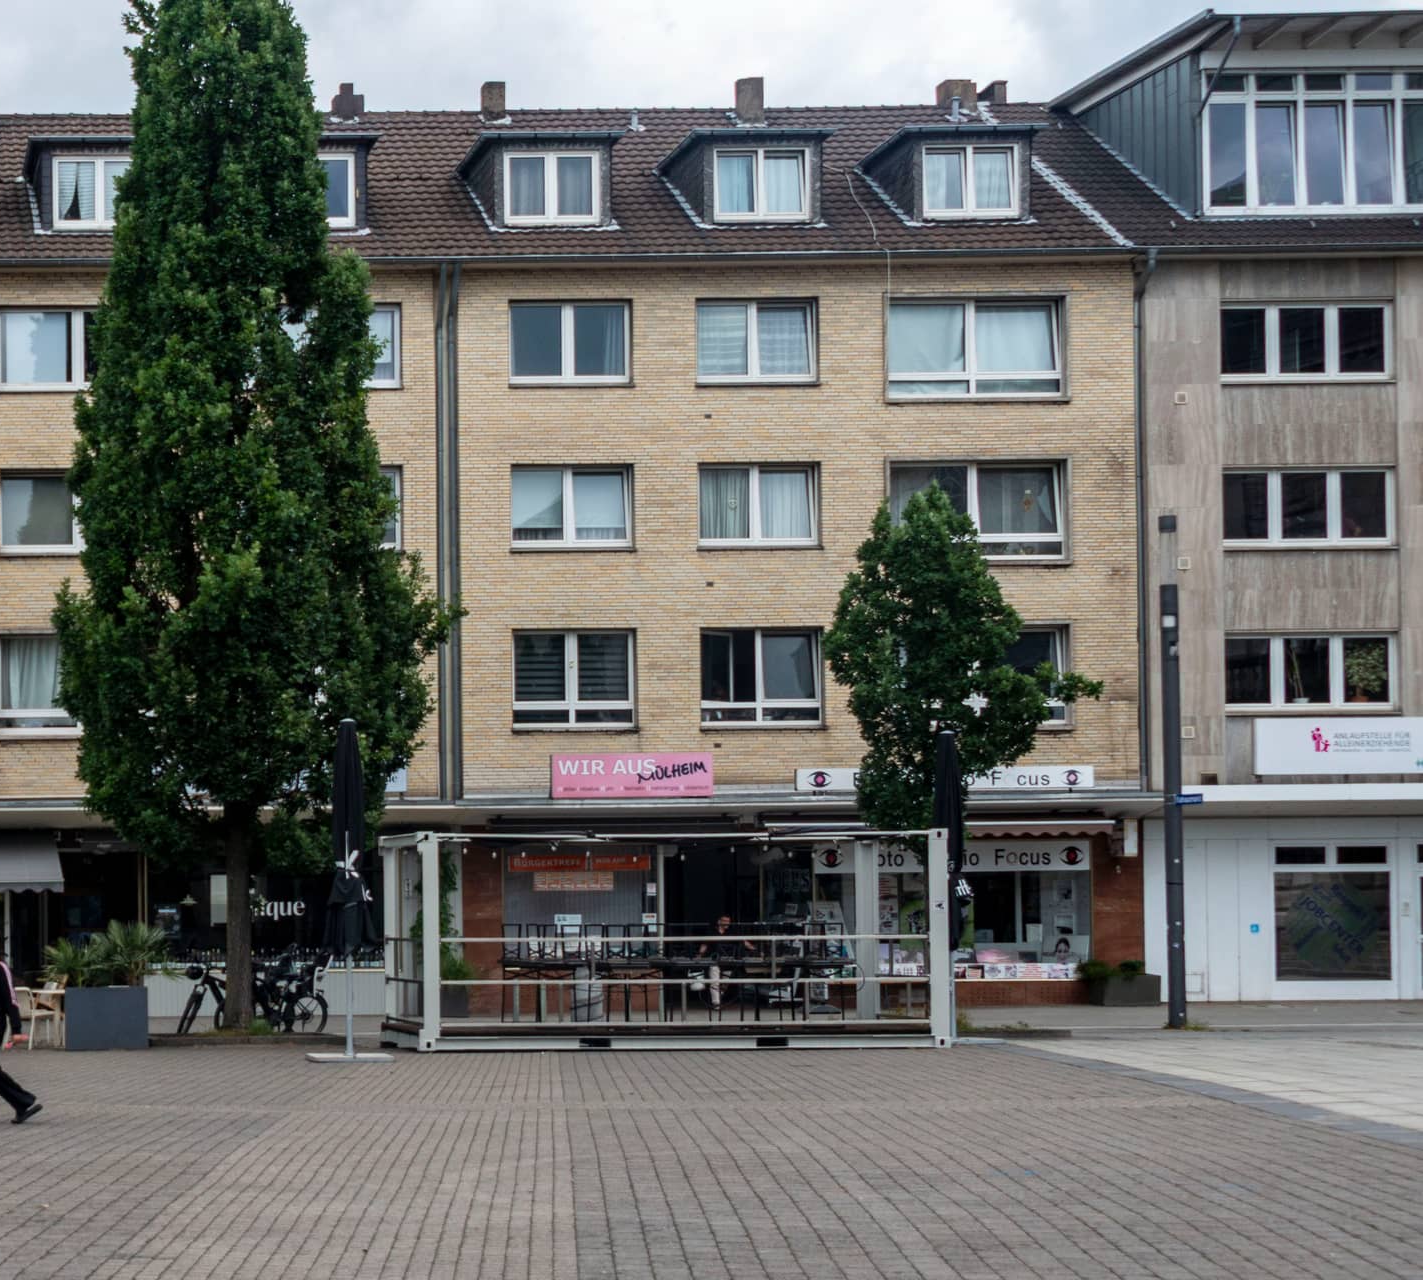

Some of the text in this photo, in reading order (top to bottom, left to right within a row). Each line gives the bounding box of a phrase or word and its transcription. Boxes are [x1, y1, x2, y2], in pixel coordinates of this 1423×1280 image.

[558, 758, 708, 784] WIR AUS MÜLHEIM
[994, 848, 1051, 866] Focus
